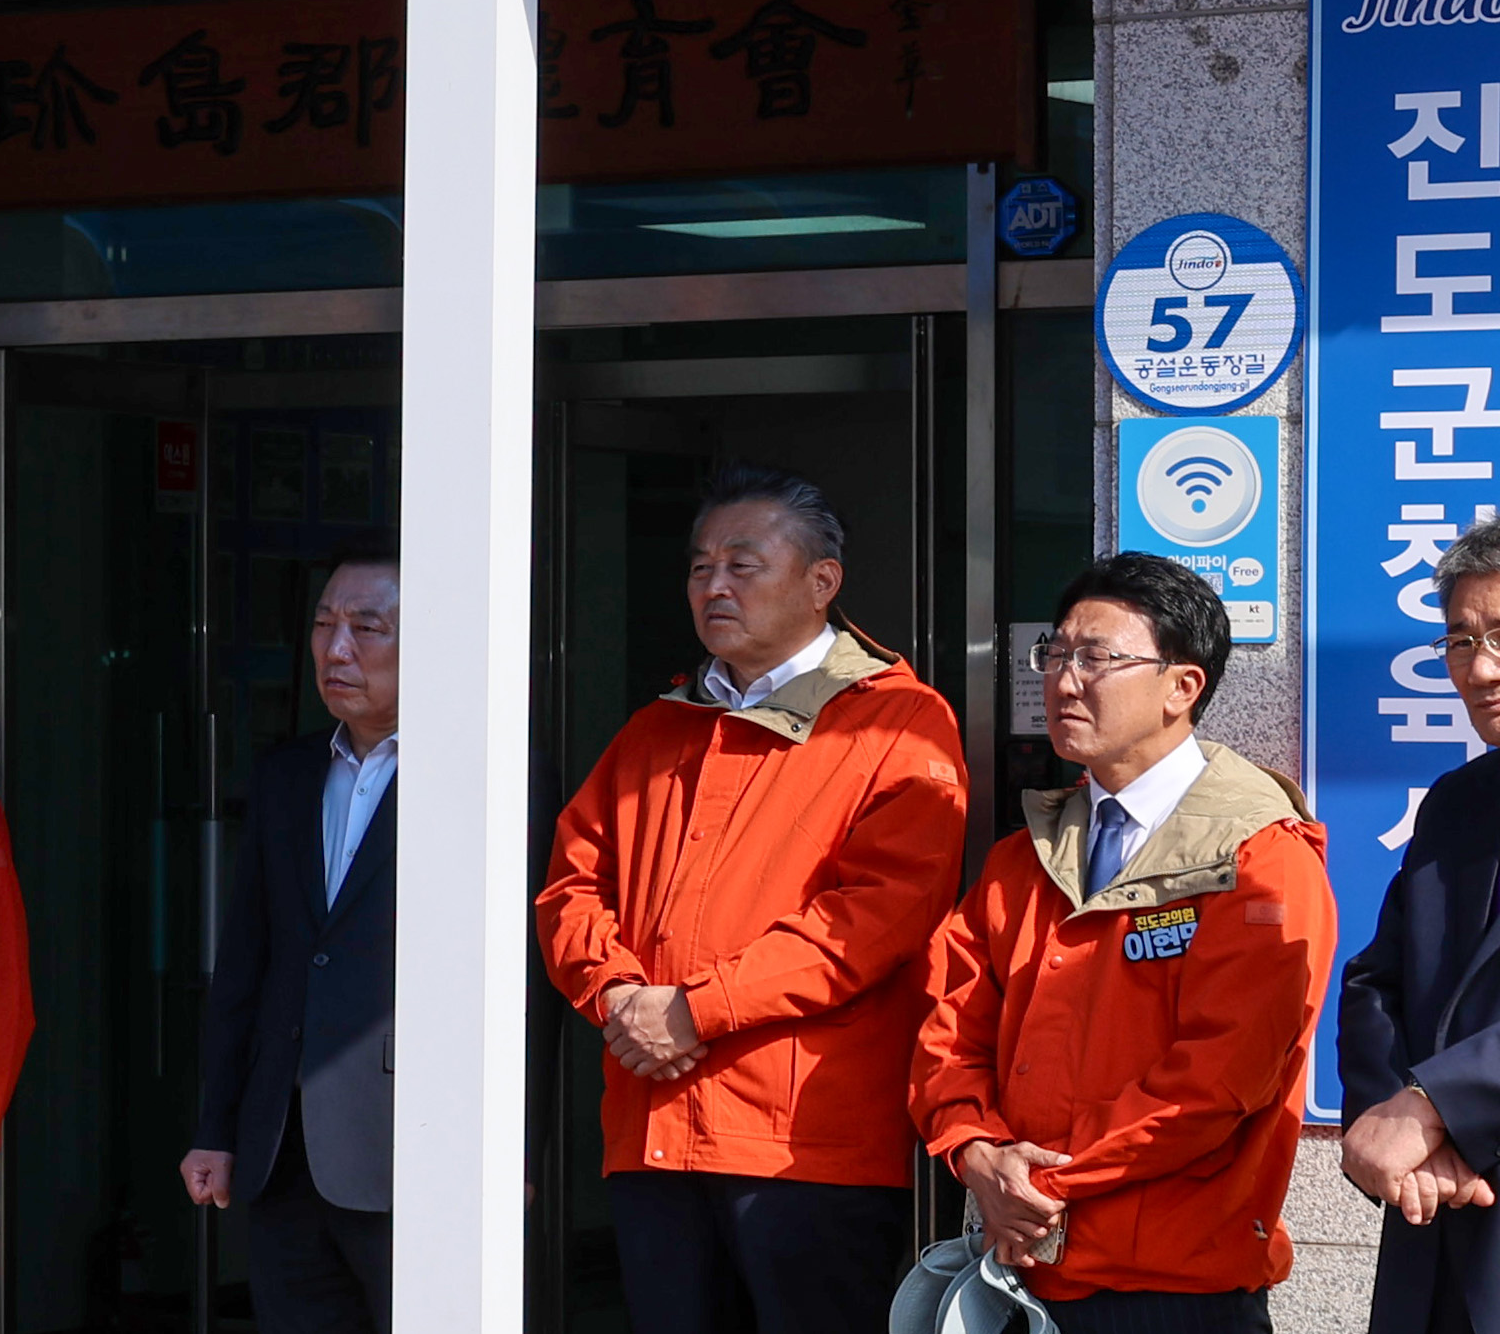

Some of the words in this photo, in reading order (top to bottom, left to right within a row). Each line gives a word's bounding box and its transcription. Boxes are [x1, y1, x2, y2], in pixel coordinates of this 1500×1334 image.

[1009, 202, 1063, 230] ADT
[1176, 259, 1215, 271] Jindo
[1147, 293, 1256, 353] 57
[1134, 354, 1265, 379] 공설운동장길
[1233, 566, 1259, 576] Free
[1249, 605, 1260, 614] kt
[1134, 907, 1196, 932] 진도군의원
